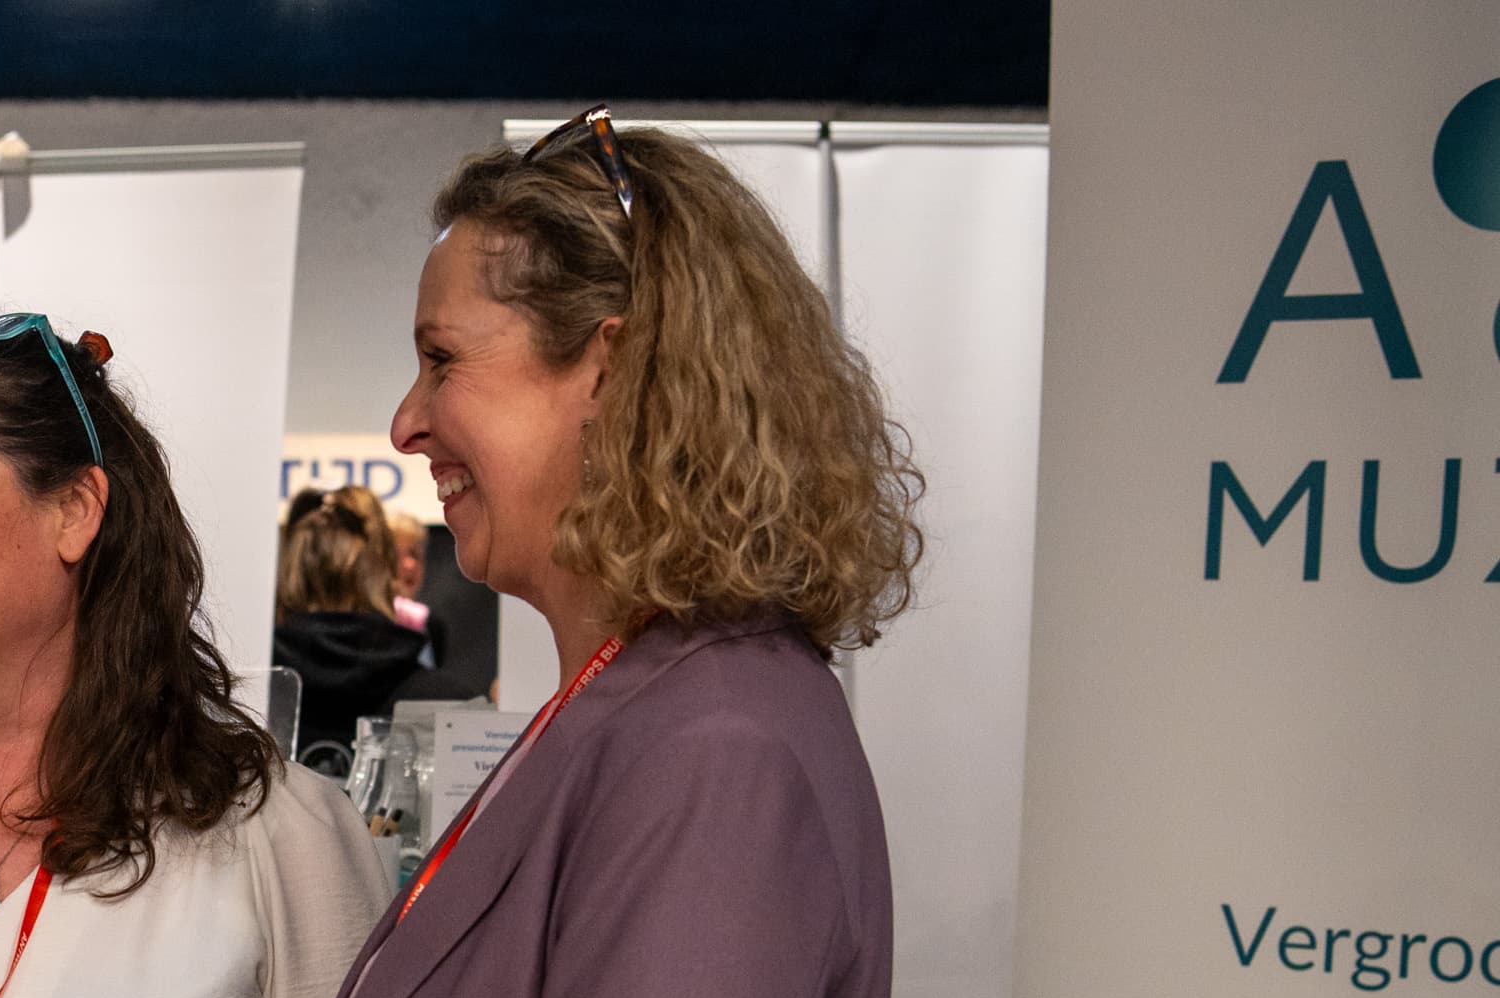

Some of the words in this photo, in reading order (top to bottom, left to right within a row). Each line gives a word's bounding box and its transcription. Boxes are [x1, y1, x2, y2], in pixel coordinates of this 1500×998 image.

[1216, 160, 1423, 384] A
[1203, 458, 1500, 584] MU
[599, 637, 623, 663] BU
